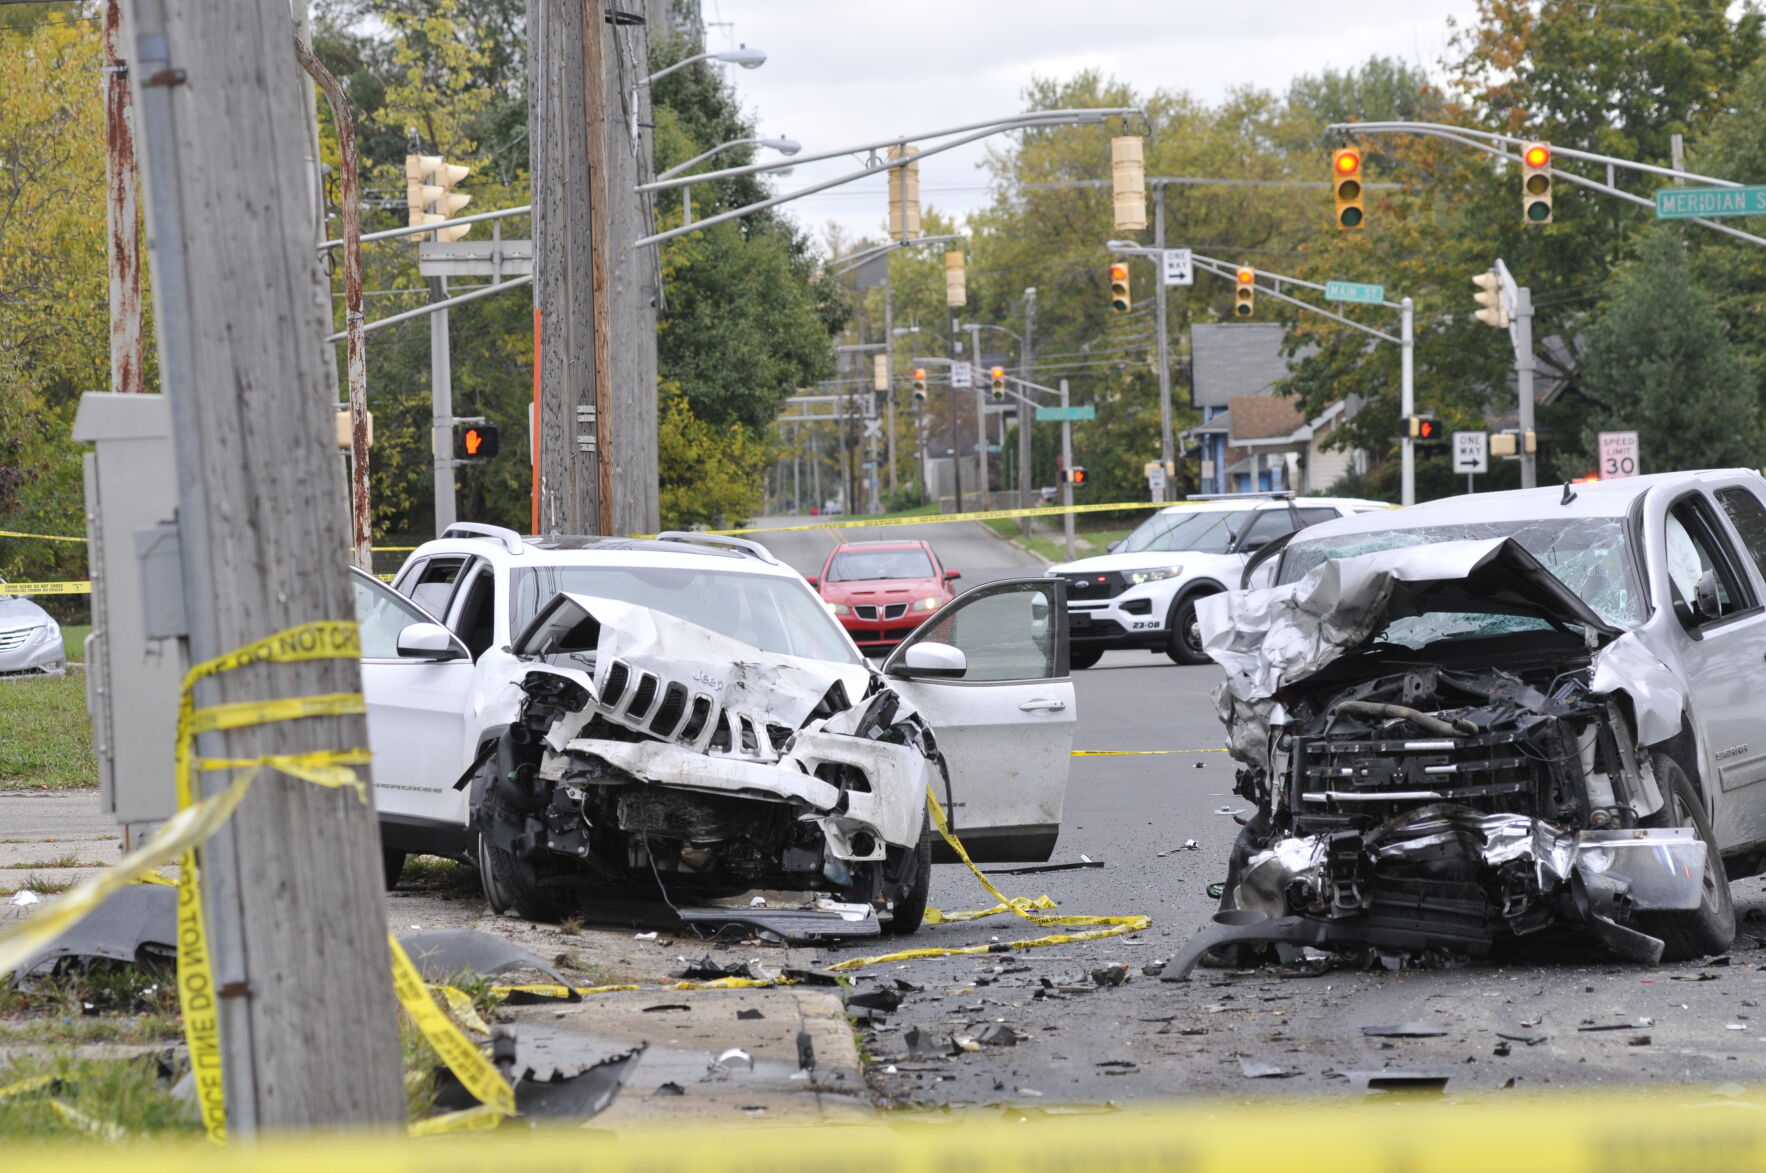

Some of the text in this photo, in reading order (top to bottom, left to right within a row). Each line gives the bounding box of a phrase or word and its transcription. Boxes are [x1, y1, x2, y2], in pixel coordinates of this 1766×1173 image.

[1663, 191, 1766, 213] MERIDIAN S
[1168, 252, 1185, 260] ONE
[1168, 262, 1187, 270] WAY
[1331, 286, 1356, 297] MAIN
[1460, 436, 1480, 445] ONE
[1604, 438, 1635, 447] SPEED
[1460, 446, 1481, 456] WAY
[1606, 447, 1632, 456] LIMIT
[1605, 457, 1635, 475] 30
[278, 626, 325, 654] NOT
[692, 668, 724, 692] Jeep
